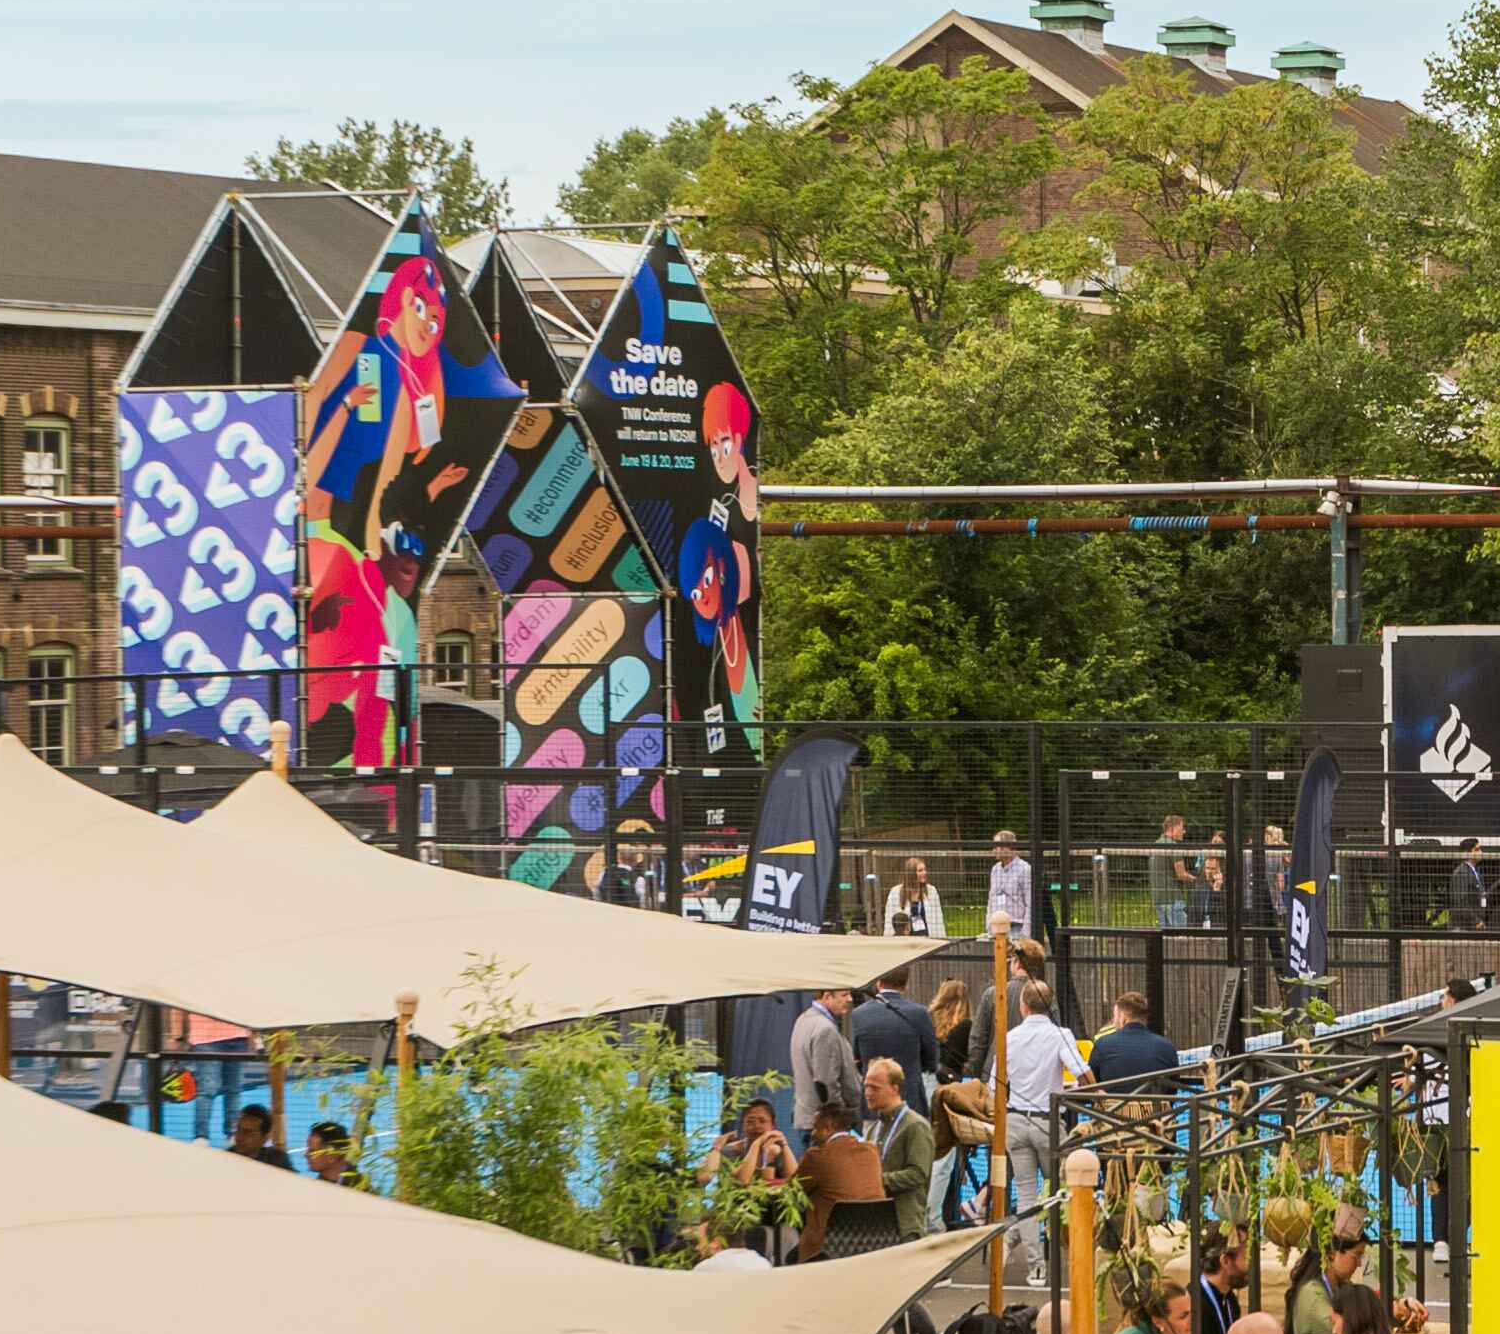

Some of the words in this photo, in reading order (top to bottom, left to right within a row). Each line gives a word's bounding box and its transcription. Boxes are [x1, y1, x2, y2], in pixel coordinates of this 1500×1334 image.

[624, 337, 683, 366] Save
[609, 367, 648, 396] the
[649, 370, 699, 399] date
[621, 406, 642, 421] TNW
[643, 408, 692, 425] Conference
[616, 426, 632, 441] will
[633, 429, 658, 442] return
[659, 430, 668, 442] to
[620, 453, 641, 468] June
[641, 454, 651, 468] 19
[651, 454, 658, 468] &
[674, 455, 696, 470] 2025
[530, 618, 610, 708] #mobility
[706, 808, 726, 826] THE
[752, 863, 803, 910] EY
[749, 907, 785, 927] Building
[785, 917, 793, 928] a
[793, 917, 821, 935] better
[1217, 978, 1237, 1039] INSTANTPADEL
